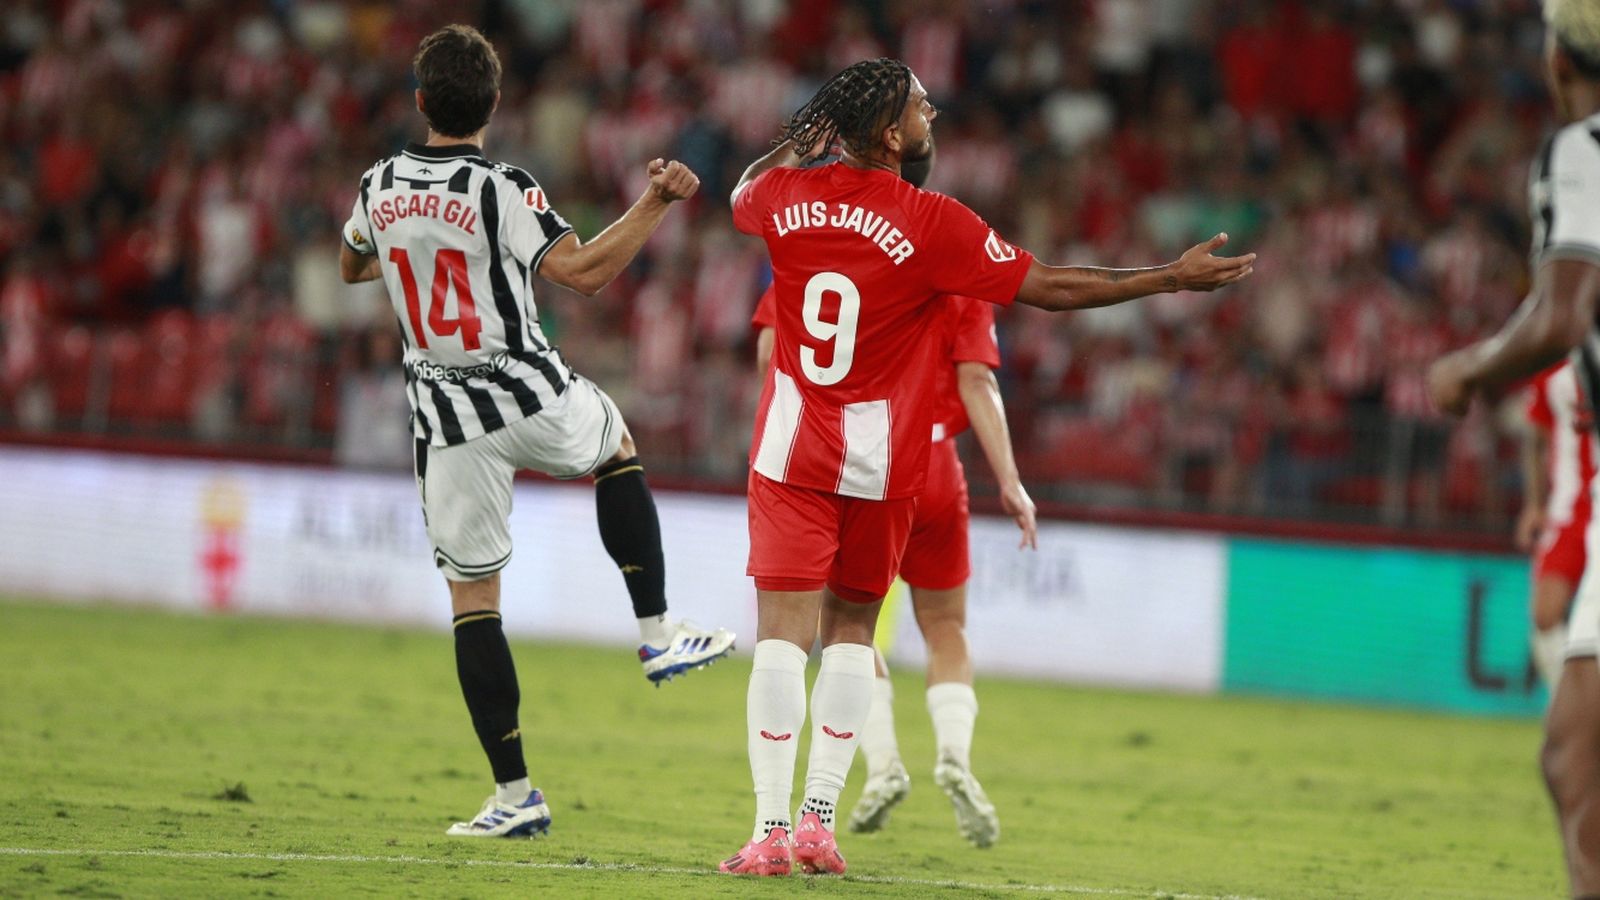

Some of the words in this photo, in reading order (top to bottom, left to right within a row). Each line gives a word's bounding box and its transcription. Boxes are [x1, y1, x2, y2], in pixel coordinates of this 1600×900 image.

[444, 200, 478, 235] GIL
[773, 201, 827, 237] LUIS
[831, 203, 914, 265] JAVIER
[389, 247, 482, 350] 14
[799, 271, 861, 386] 9
